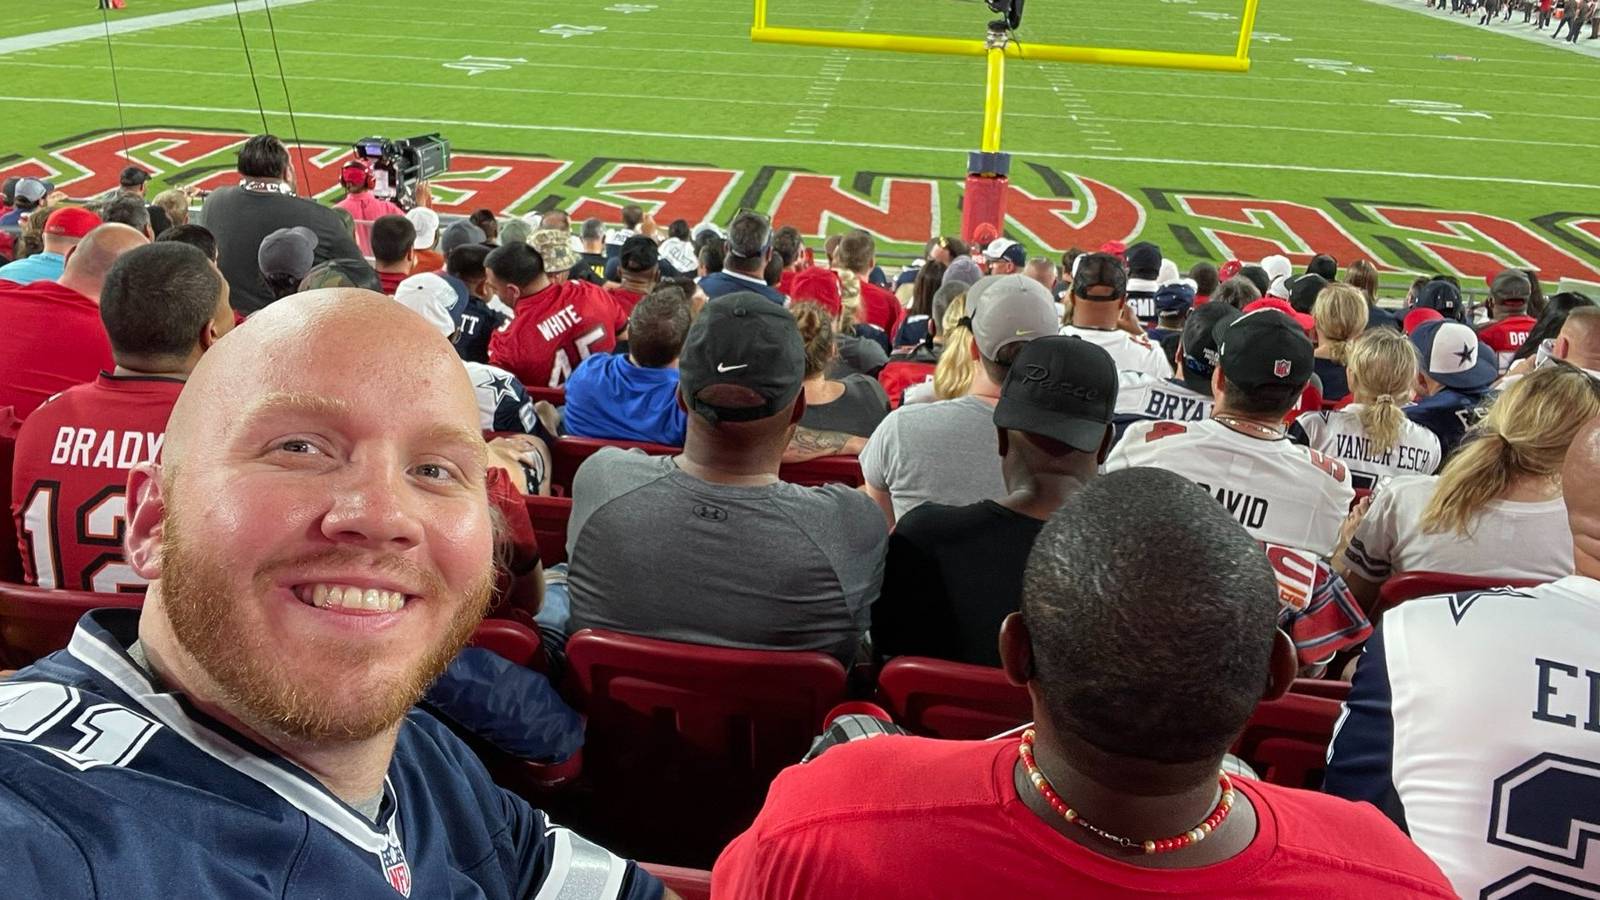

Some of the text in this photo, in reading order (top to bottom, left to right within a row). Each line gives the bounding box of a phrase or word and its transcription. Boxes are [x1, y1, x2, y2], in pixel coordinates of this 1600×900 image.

[536, 304, 582, 342] WHITE
[51, 426, 165, 469] BRADY
[1397, 445, 1430, 472] ESCH
